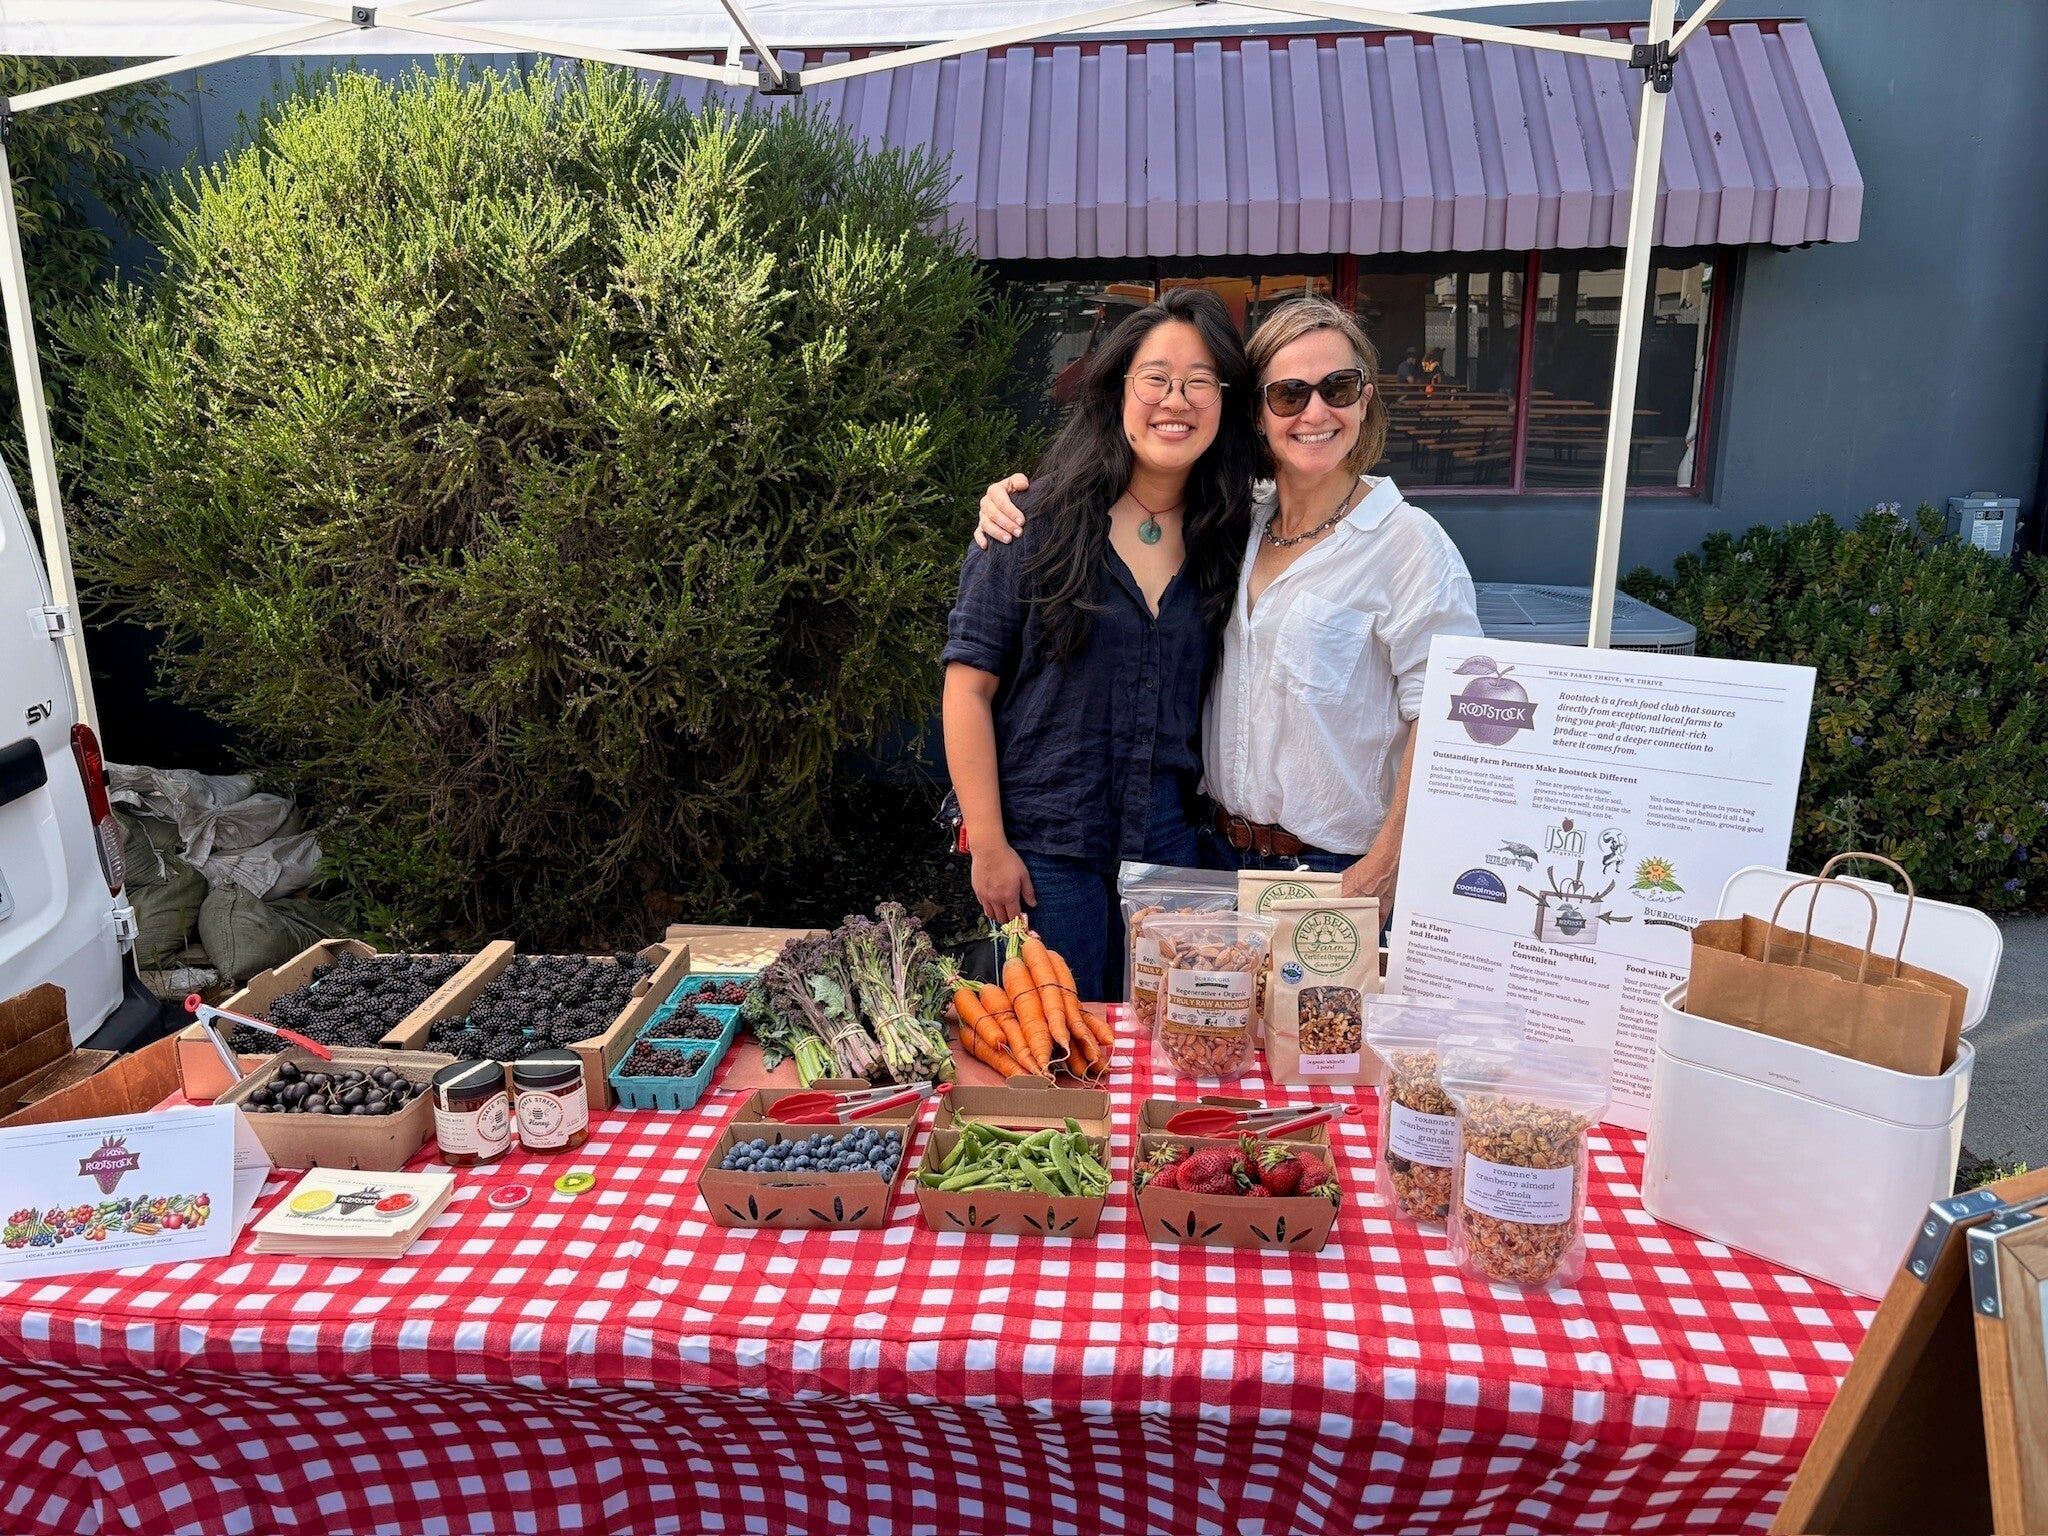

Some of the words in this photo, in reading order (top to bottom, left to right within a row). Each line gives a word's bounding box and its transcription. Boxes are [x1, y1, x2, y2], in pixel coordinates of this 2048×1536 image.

[1458, 702, 1526, 721] ROOTSTOCK
[1558, 691, 1600, 703] Rootstock
[1601, 696, 1608, 704] is
[1615, 697, 1638, 709] fresh
[1638, 700, 1659, 711] food
[1660, 702, 1679, 712] club
[1680, 704, 1700, 714] that
[1700, 709, 1735, 718] sources
[26, 700, 52, 726] SV
[1557, 702, 1588, 715] directly
[1587, 706, 1610, 717] from
[1611, 708, 1661, 723] exceptional
[1662, 714, 1684, 724] local
[1682, 716, 1711, 729] farms
[1713, 720, 1723, 728] to
[1555, 714, 1577, 725] bring
[1577, 719, 1594, 727] you
[1594, 718, 1647, 734] peak-flavor,
[1648, 724, 1707, 739] nutrient-rich
[1552, 737, 1577, 747] where
[1578, 740, 1585, 748] it
[1586, 743, 1612, 752] comes
[1613, 744, 1637, 756] from.
[1622, 734, 1652, 746] deeper
[1653, 737, 1702, 751] connection
[1703, 743, 1713, 752] to
[1432, 750, 1478, 763] Outstanding
[1480, 756, 1499, 765] Farm
[1501, 759, 1534, 770] Partners
[1535, 764, 1556, 773] Make
[1558, 767, 1597, 778] Rootstock
[1599, 772, 1637, 784] Different
[1644, 906, 1698, 924] BURROUGHS
[1299, 917, 1321, 940] FULL
[1324, 915, 1353, 940] BELLY
[1409, 928, 1422, 937] and
[1424, 932, 1448, 942] Health
[1410, 920, 1427, 929] Peak
[1428, 923, 1451, 934] Flavor
[1512, 950, 1556, 966] Convenient
[1513, 940, 1547, 955] Flexible,
[1548, 948, 1596, 966] Thoughtful,
[1626, 964, 1645, 974] Food
[1647, 968, 1667, 978] with
[1176, 987, 1216, 996] Regenerative
[1223, 991, 1246, 999] Organic
[1172, 997, 1195, 1006] TRULY
[1196, 1000, 1214, 1008] RAW
[534, 1097, 557, 1110] STREET
[1400, 1119, 1438, 1135] cranberry
[1414, 1116, 1455, 1126] roxanne's
[1418, 1135, 1450, 1145] granola
[86, 1157, 133, 1171] ROOTSTOCK
[1476, 1172, 1518, 1189] cranberry
[1520, 1182, 1555, 1190] almond
[1492, 1168, 1538, 1180] roxanne's
[1496, 1188, 1531, 1199] granola
